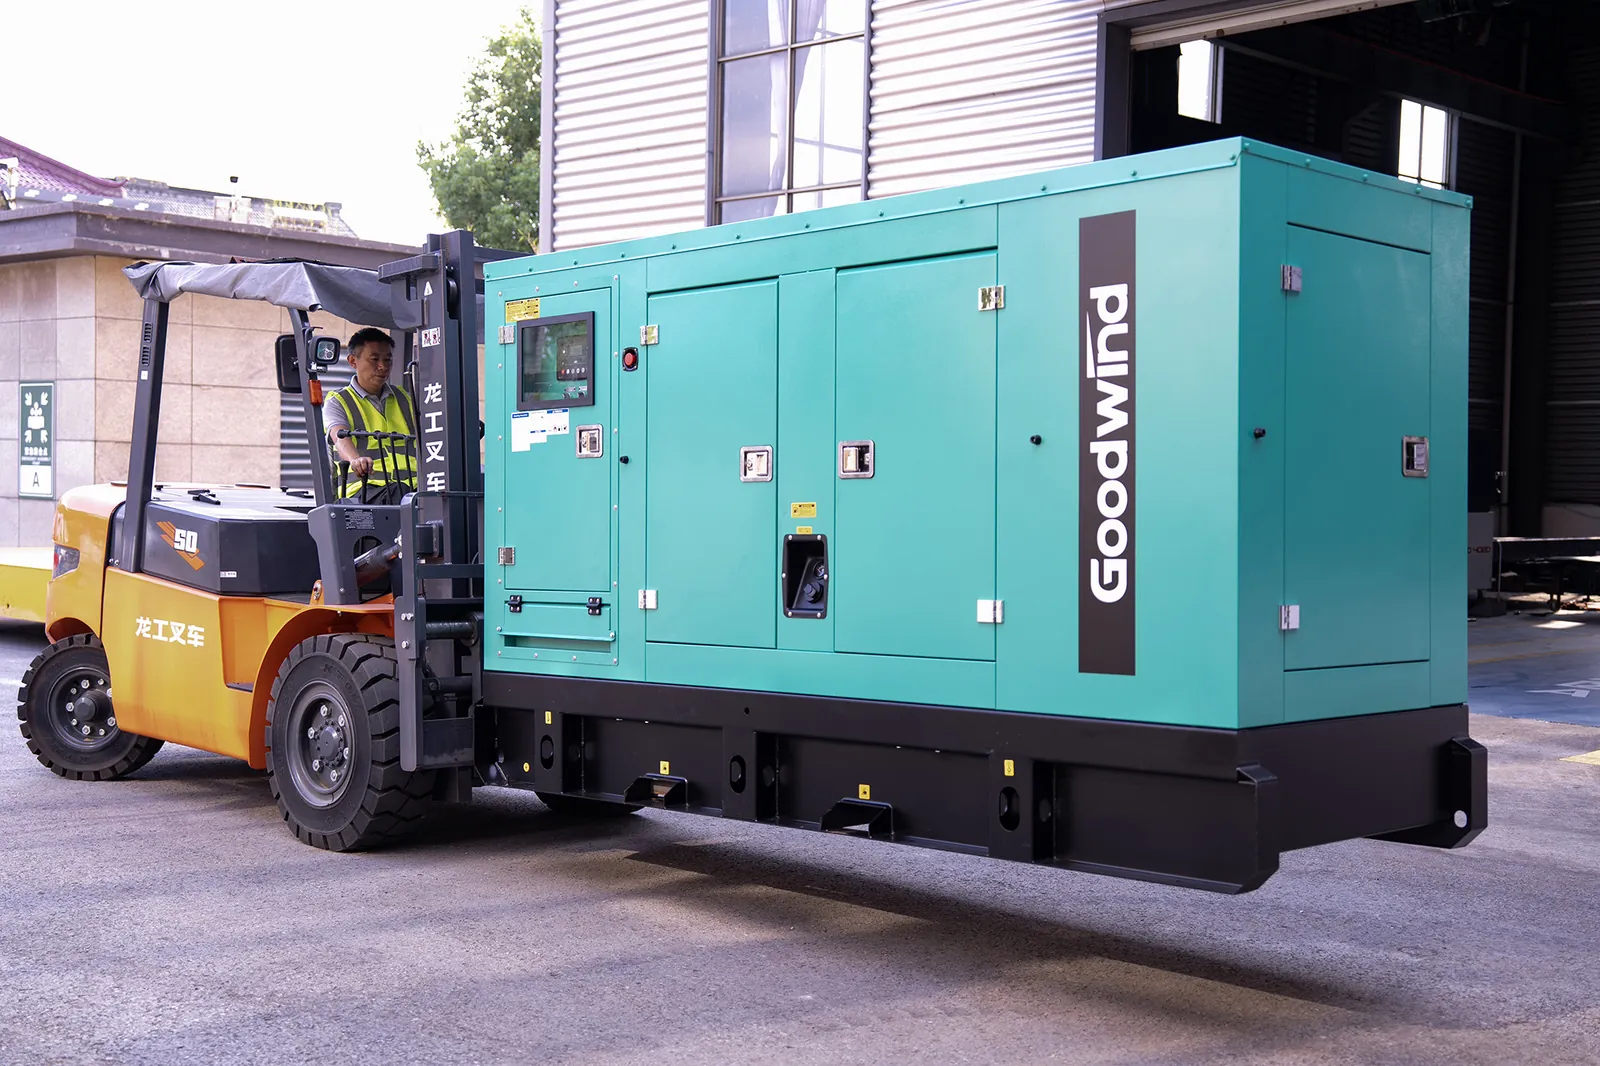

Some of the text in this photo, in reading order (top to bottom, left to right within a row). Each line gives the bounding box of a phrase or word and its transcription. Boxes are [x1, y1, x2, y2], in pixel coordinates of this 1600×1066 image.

[424, 382, 445, 492] 龙工叉车
[1086, 283, 1130, 604] Goodwind
[32, 471, 40, 488] A
[174, 528, 199, 554] 50
[135, 616, 205, 648] 龙工叉车
